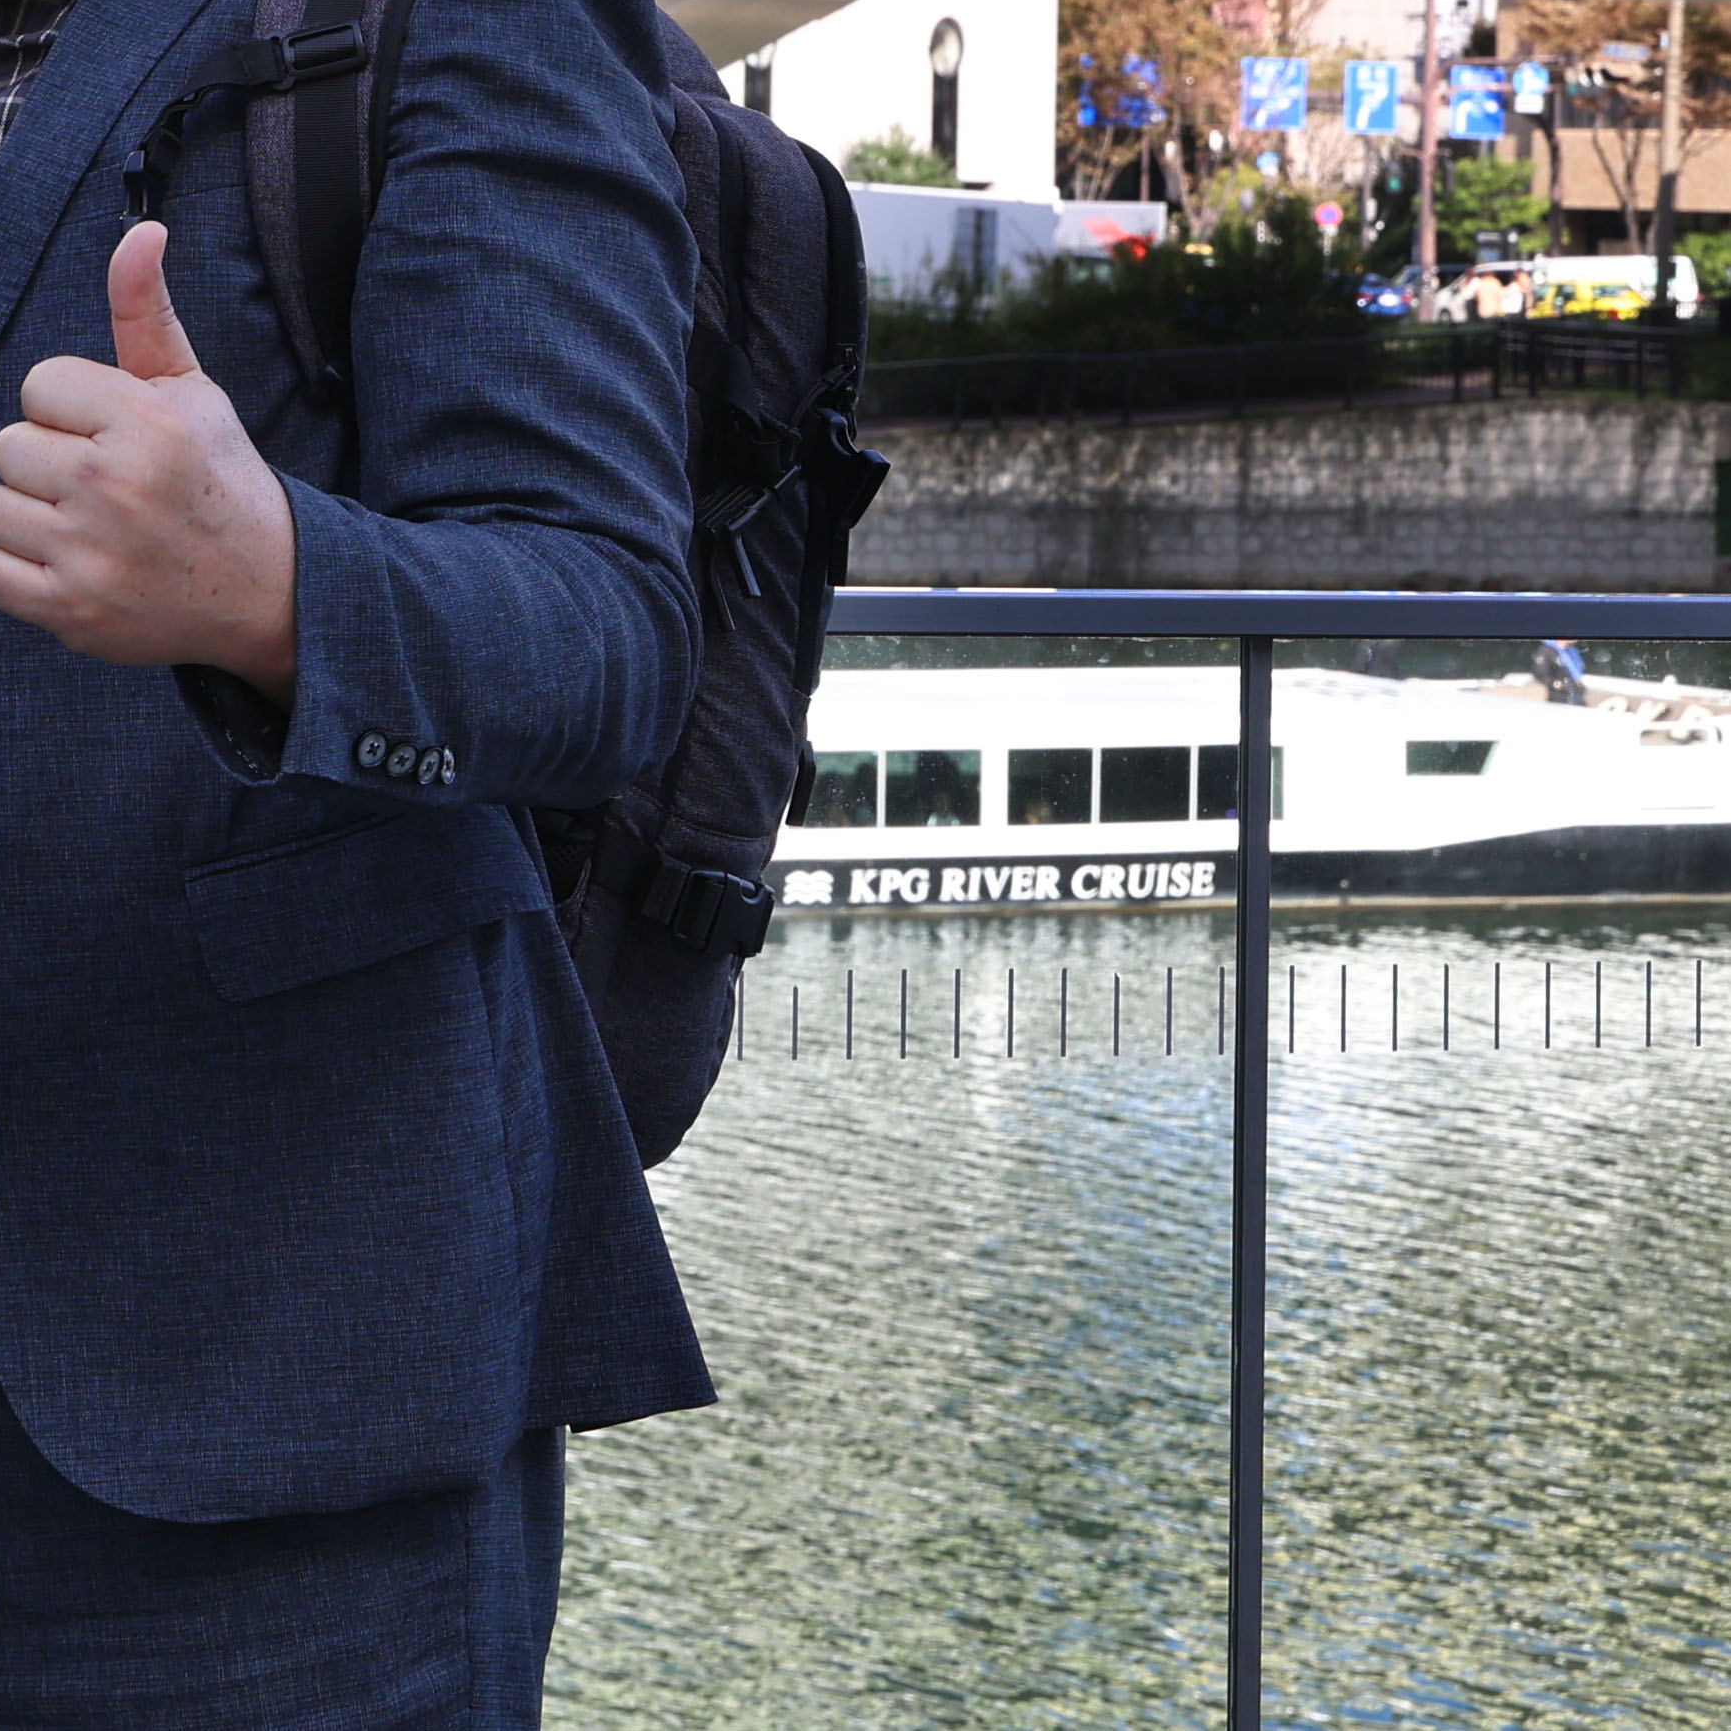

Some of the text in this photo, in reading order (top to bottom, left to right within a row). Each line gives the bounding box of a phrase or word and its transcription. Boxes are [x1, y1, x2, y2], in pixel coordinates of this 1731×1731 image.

[849, 861, 1216, 903] KPG RIVER CRUISE
